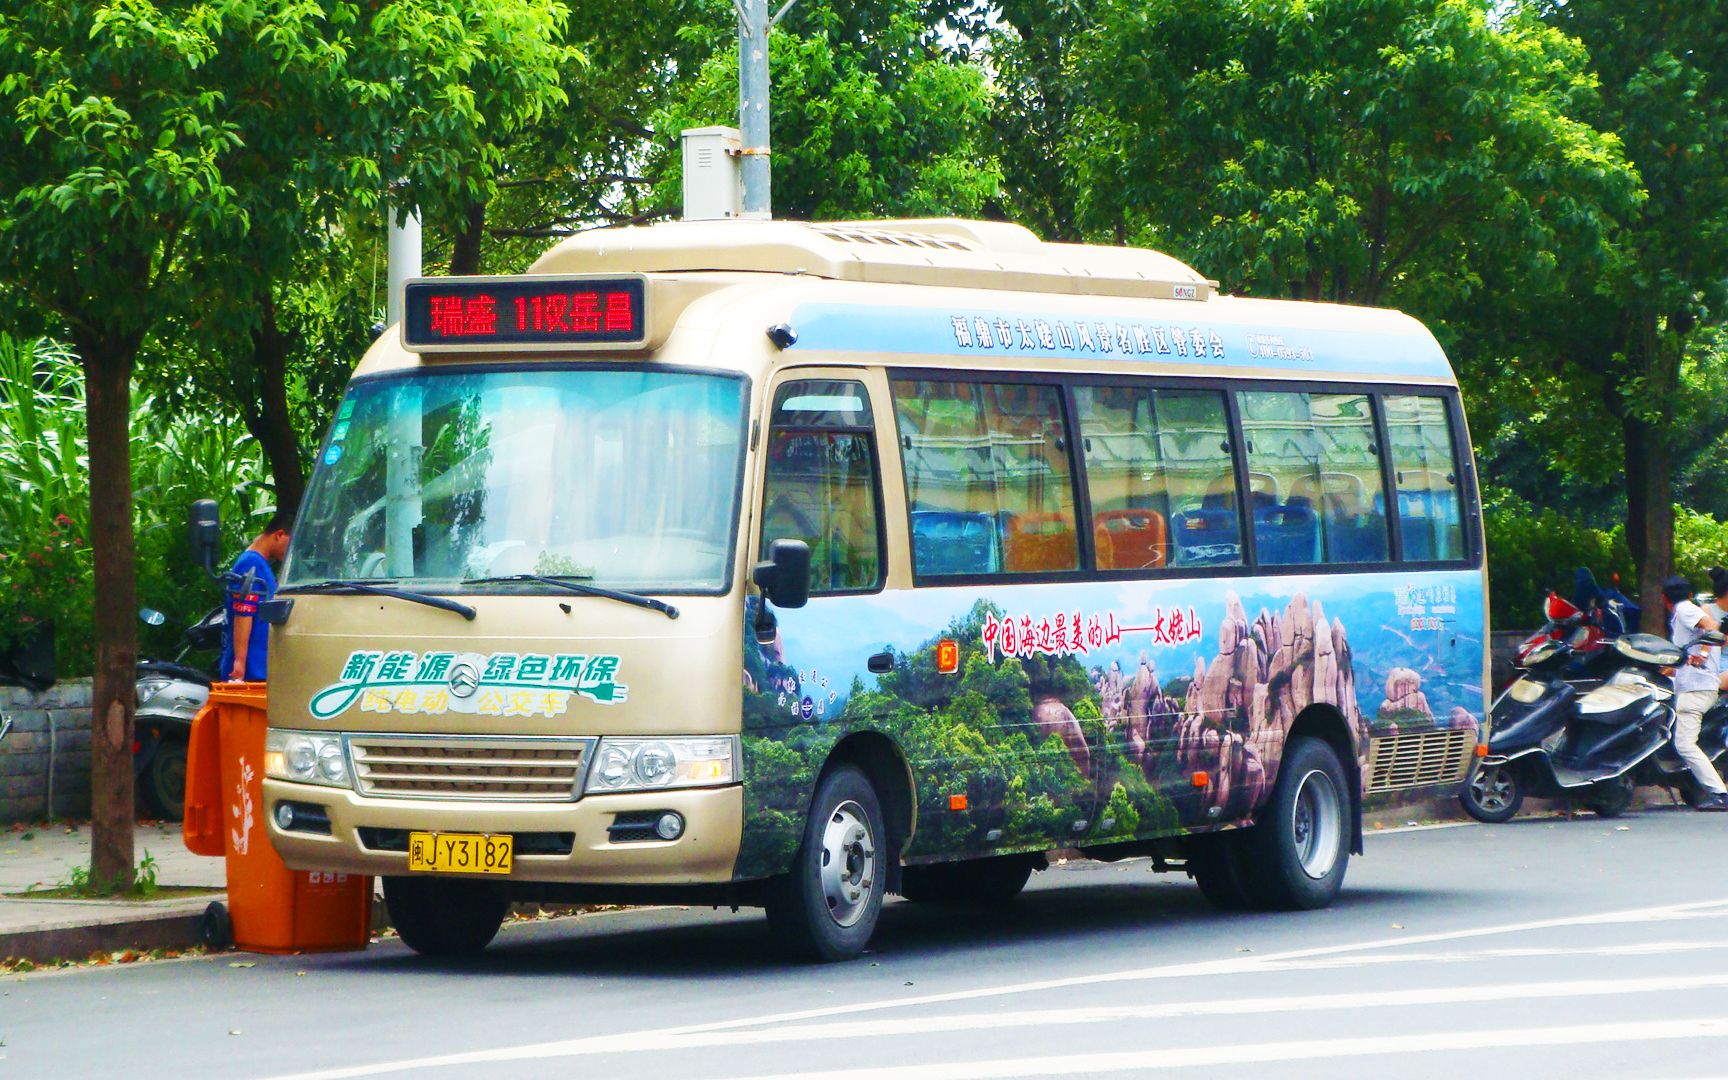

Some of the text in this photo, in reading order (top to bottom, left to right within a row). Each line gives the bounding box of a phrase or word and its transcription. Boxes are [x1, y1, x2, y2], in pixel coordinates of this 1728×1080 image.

[430, 294, 497, 336] 瑞盛
[342, 653, 621, 682] 新能源 绿色环保
[364, 690, 570, 715] 纯电动 公交车
